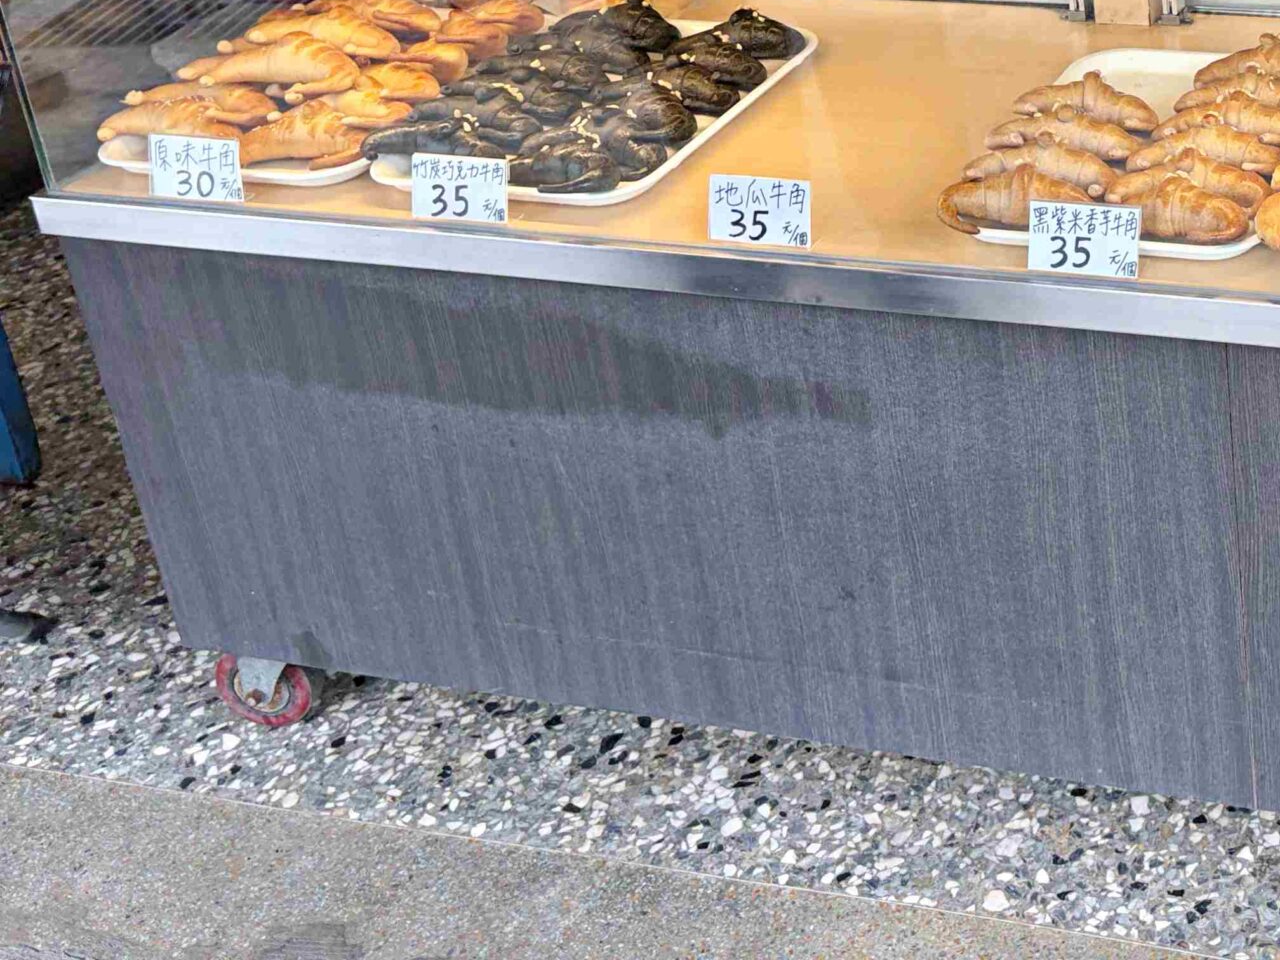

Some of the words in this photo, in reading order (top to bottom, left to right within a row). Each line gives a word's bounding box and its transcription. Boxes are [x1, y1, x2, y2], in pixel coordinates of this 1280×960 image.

[154, 138, 235, 175] 原味牛角
[412, 157, 504, 186] 竹炭巧克力牛角
[176, 169, 215, 198] 30
[430, 183, 469, 217] 35
[714, 178, 806, 214] 地瓜牛角
[728, 208, 769, 241] 35
[1032, 205, 1138, 241] 黑紫米香芋牛角
[1049, 235, 1092, 269] 35
